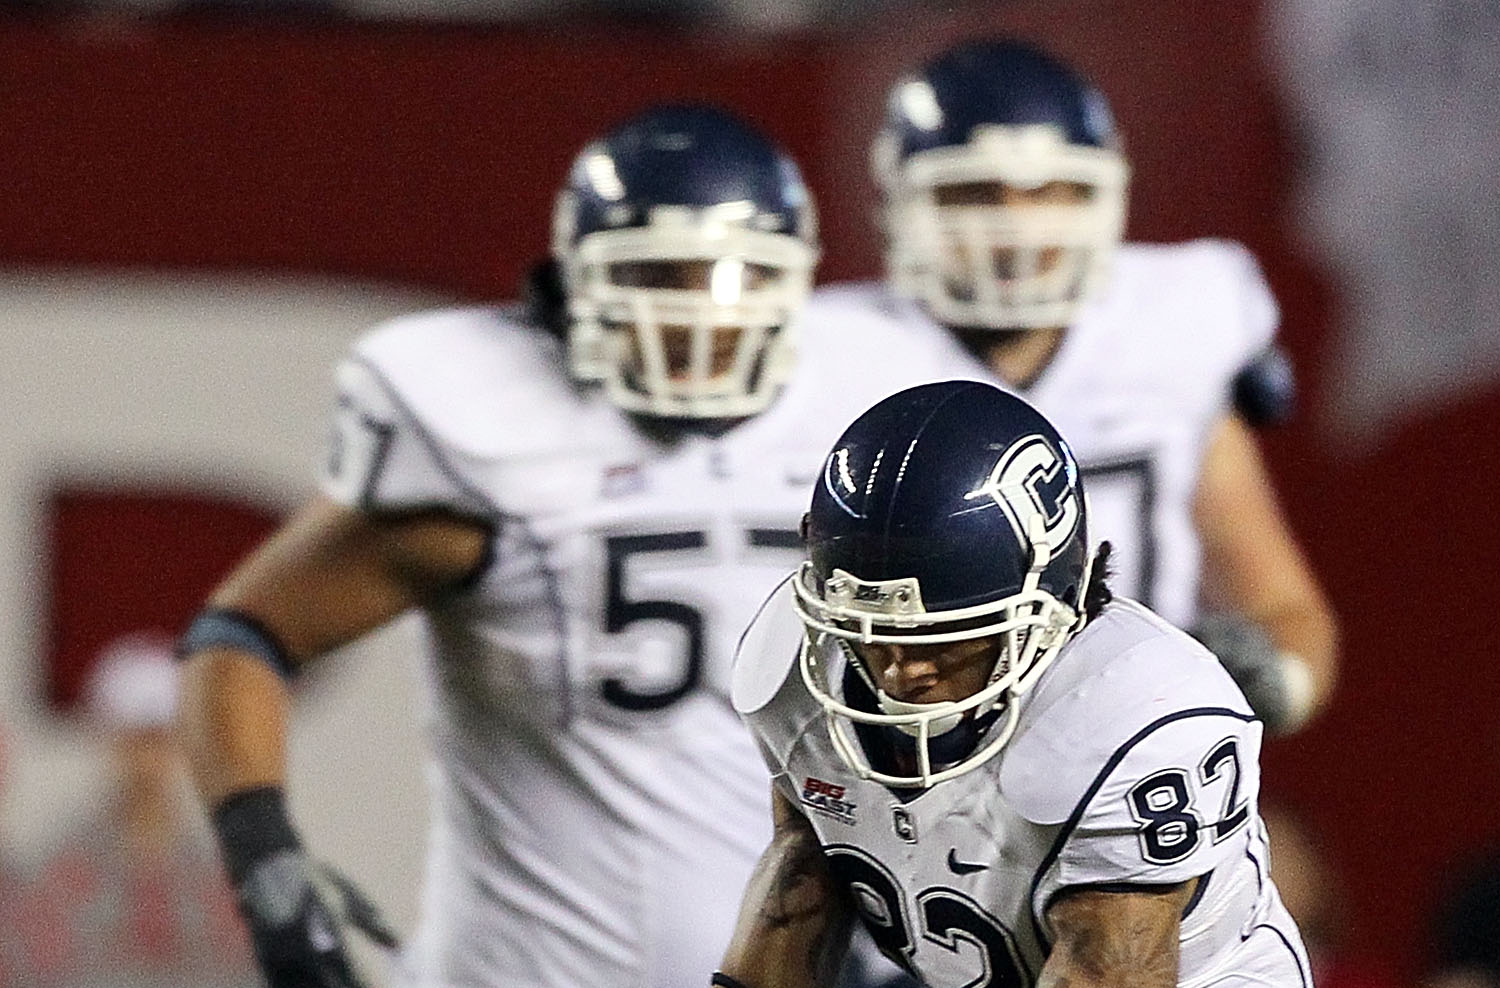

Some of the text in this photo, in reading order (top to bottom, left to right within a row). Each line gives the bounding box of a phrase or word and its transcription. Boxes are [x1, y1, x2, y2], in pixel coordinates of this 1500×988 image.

[602, 529, 808, 711] 5
[804, 777, 846, 799] BIG
[1125, 735, 1250, 866] 82
